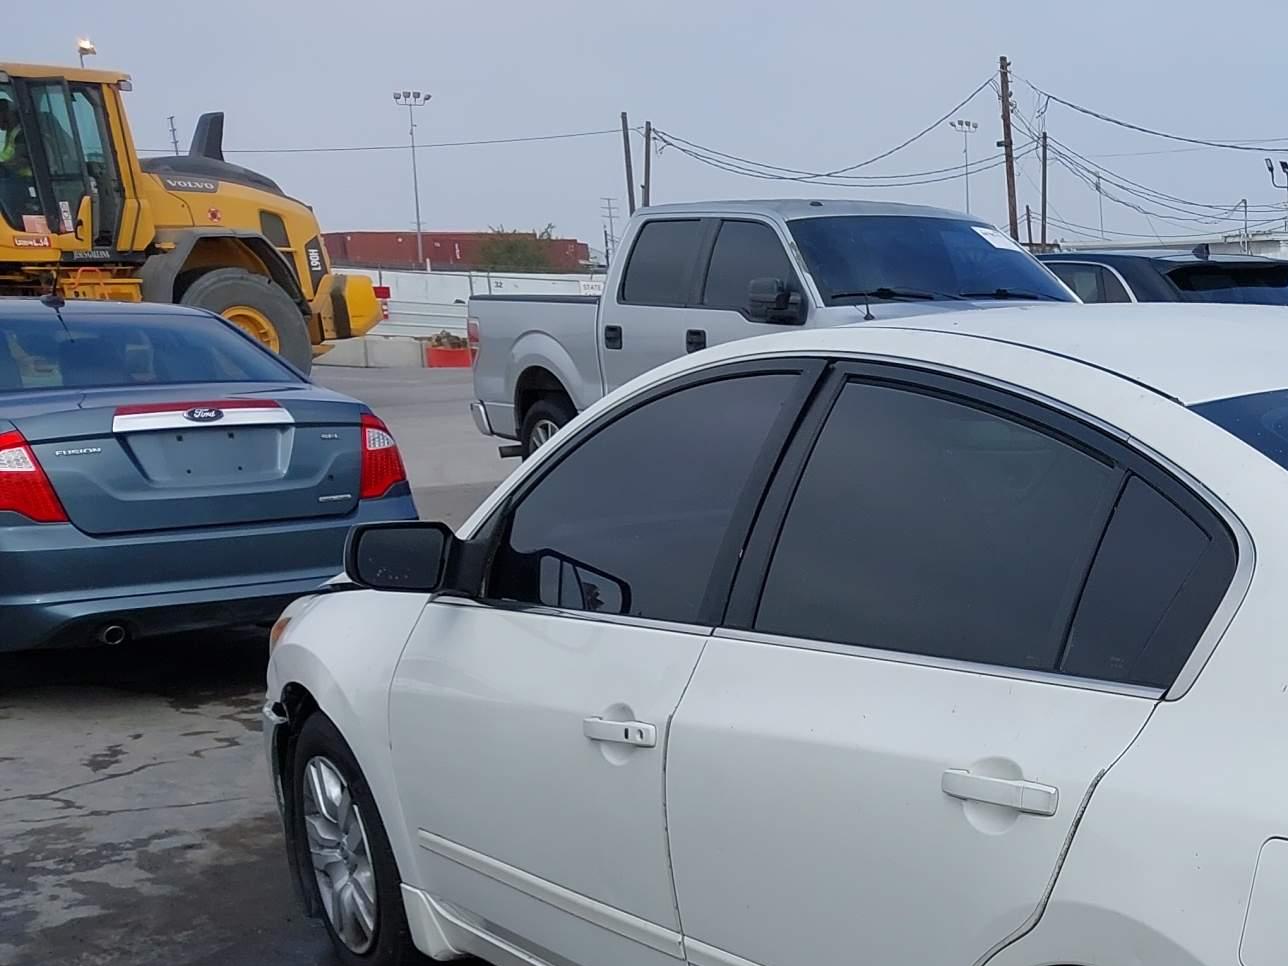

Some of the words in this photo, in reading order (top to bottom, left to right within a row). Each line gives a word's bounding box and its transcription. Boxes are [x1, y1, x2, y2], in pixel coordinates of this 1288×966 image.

[166, 179, 215, 190] VOLVO
[307, 248, 322, 271] L90H
[193, 407, 216, 419] Ford
[55, 447, 102, 457] FUSION
